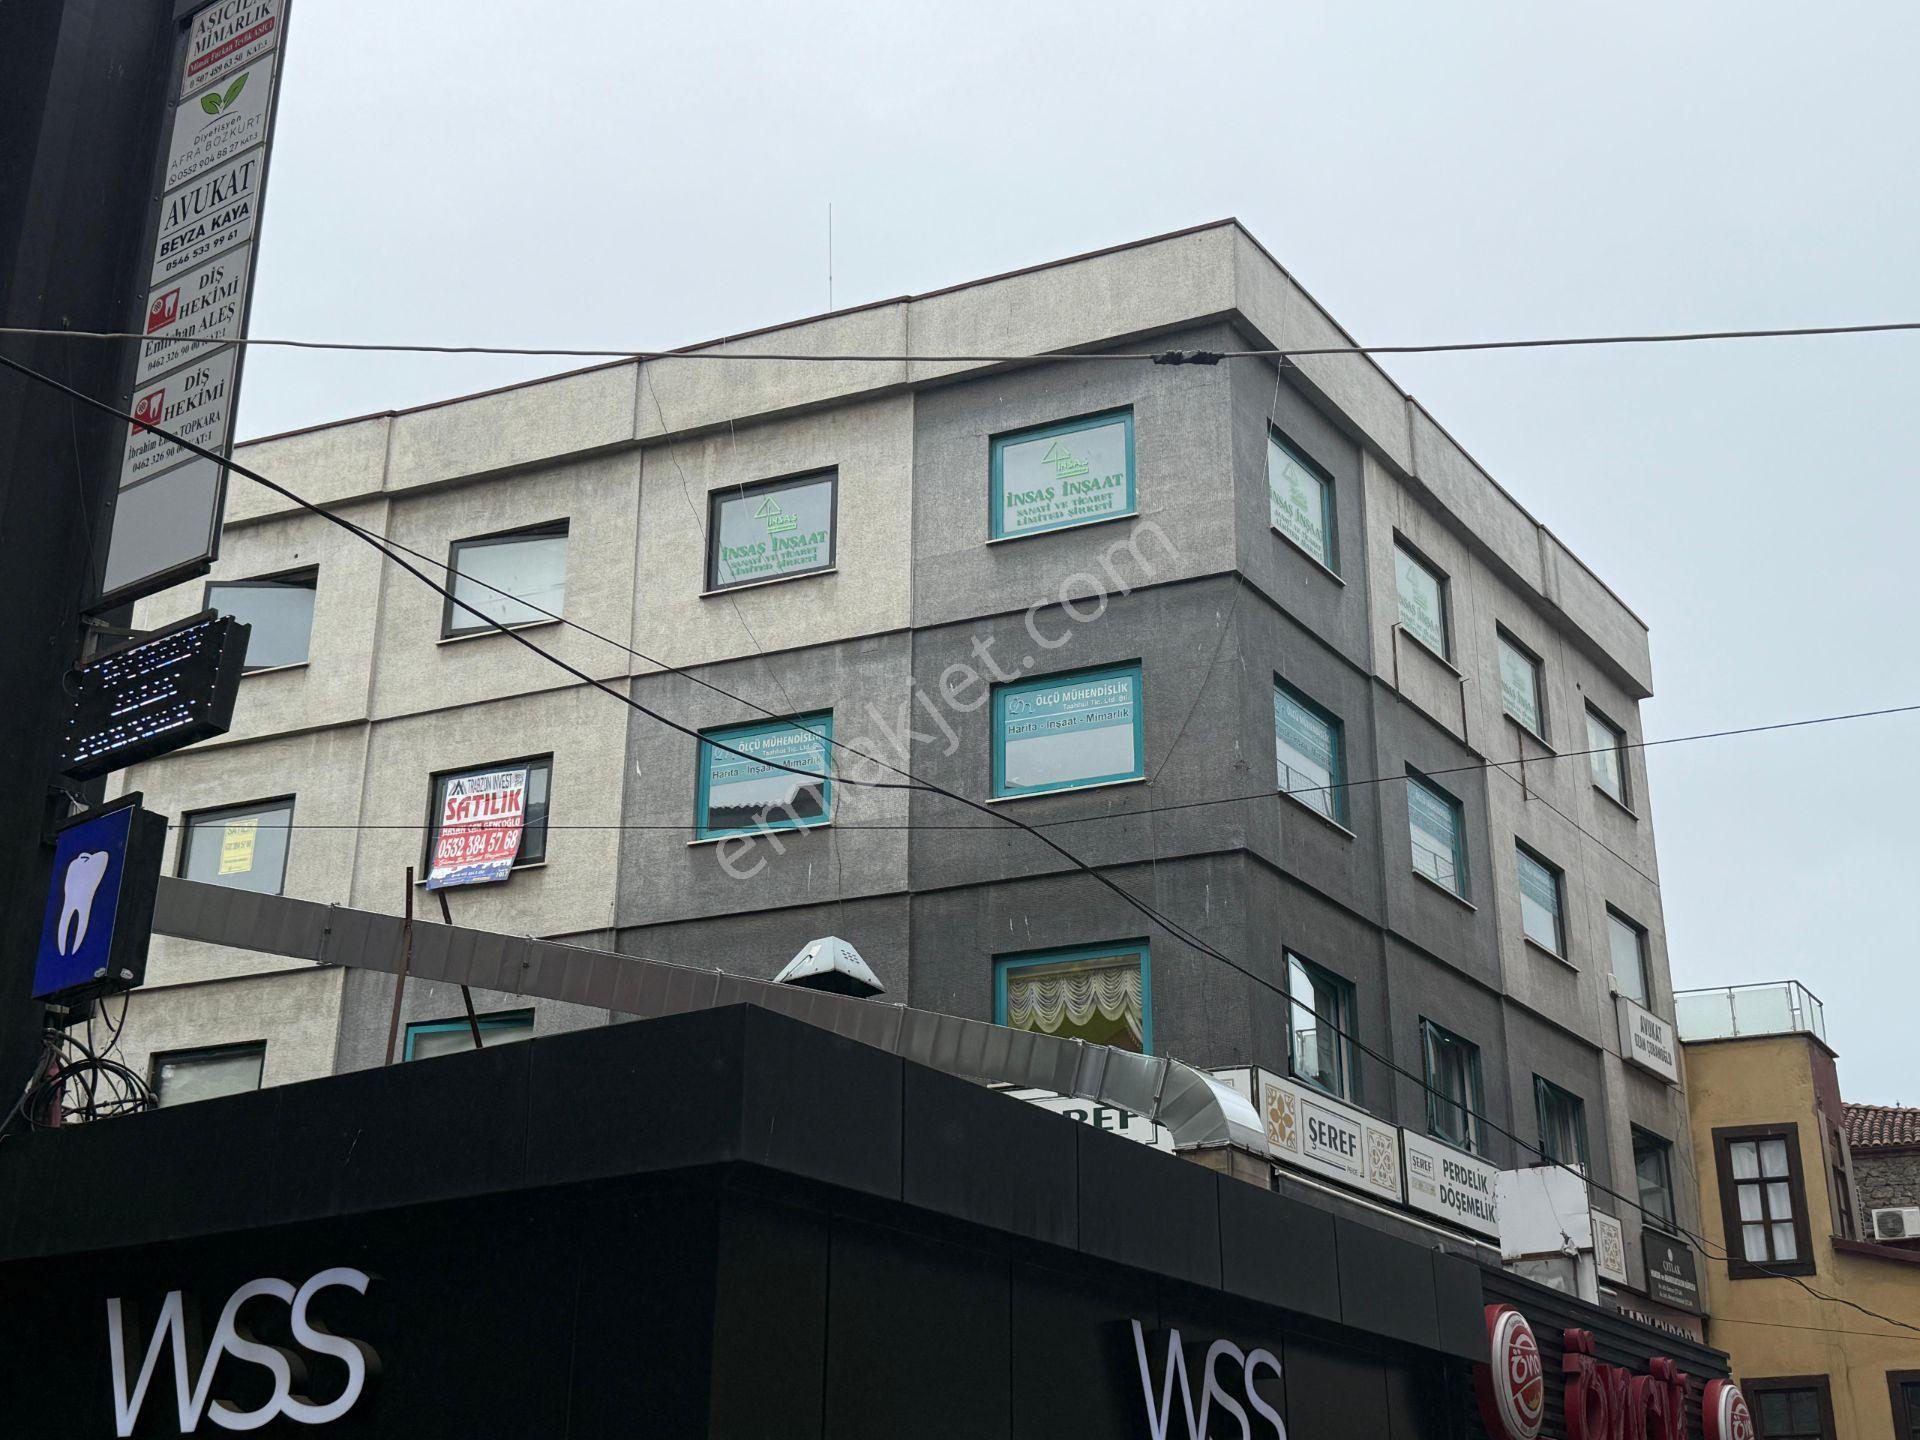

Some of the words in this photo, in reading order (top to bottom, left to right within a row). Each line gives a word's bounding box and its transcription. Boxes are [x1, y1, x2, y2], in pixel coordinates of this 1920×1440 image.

[193, 3, 271, 57] MİMARLIK
[171, 147, 201, 170] AFRA
[205, 113, 262, 152] BOZKURT
[193, 115, 242, 146] Diyetisyen
[177, 163, 199, 181] 0552
[199, 155, 215, 169] 904
[216, 148, 229, 159] 88
[229, 141, 239, 153] 27
[163, 159, 256, 231] AVUKAT
[160, 224, 206, 257] BEYZA
[211, 202, 249, 231] KAYA
[166, 252, 190, 271] 0546
[193, 243, 210, 258] 533
[213, 235, 225, 248] 99
[227, 229, 238, 241] 61
[199, 265, 224, 290] DİŞ
[179, 275, 240, 320] HEKİMİ
[198, 301, 236, 333] ALEŞ
[147, 354, 164, 371] 0462
[165, 348, 179, 363] 326
[184, 367, 210, 392] DİŞ
[164, 378, 225, 422] HEKİMİ
[179, 409, 222, 437] TOPKARA
[132, 457, 150, 473] 0462
[150, 452, 165, 466] 326
[166, 446, 175, 458] 90
[1062, 473, 1124, 498] İNŞAAT
[1016, 501, 1050, 518] SANAYİ
[1055, 501, 1068, 512] VE
[1073, 491, 1114, 508] TİCARET
[1016, 511, 1064, 527] LİMİTED
[1067, 500, 1113, 518] ŞİRKETİ
[1035, 690, 1060, 707] ÖLÇÜ
[1062, 682, 1129, 702] MÜHENDİSLİK
[1008, 722, 1037, 735] Harita
[1086, 708, 1129, 723] Mimarlık
[738, 739, 761, 754] ÖLÇÜ
[468, 777, 492, 794] TRABZON
[712, 768, 739, 780] Harita
[445, 788, 522, 822] SATILIK
[438, 836, 466, 859] 0532
[466, 833, 487, 857] 384
[487, 830, 504, 853] 57
[504, 828, 519, 850] 68
[1640, 1014, 1663, 1045] AVUKAT
[1308, 1116, 1357, 1157] ŞEREF
[1412, 1154, 1433, 1173] ŞEREF
[1442, 1158, 1490, 1196] PERDELİK
[1439, 1182, 1497, 1224] DÖŞEMELİK
[107, 1267, 370, 1438] WSS
[1131, 1318, 1288, 1440] WSS
